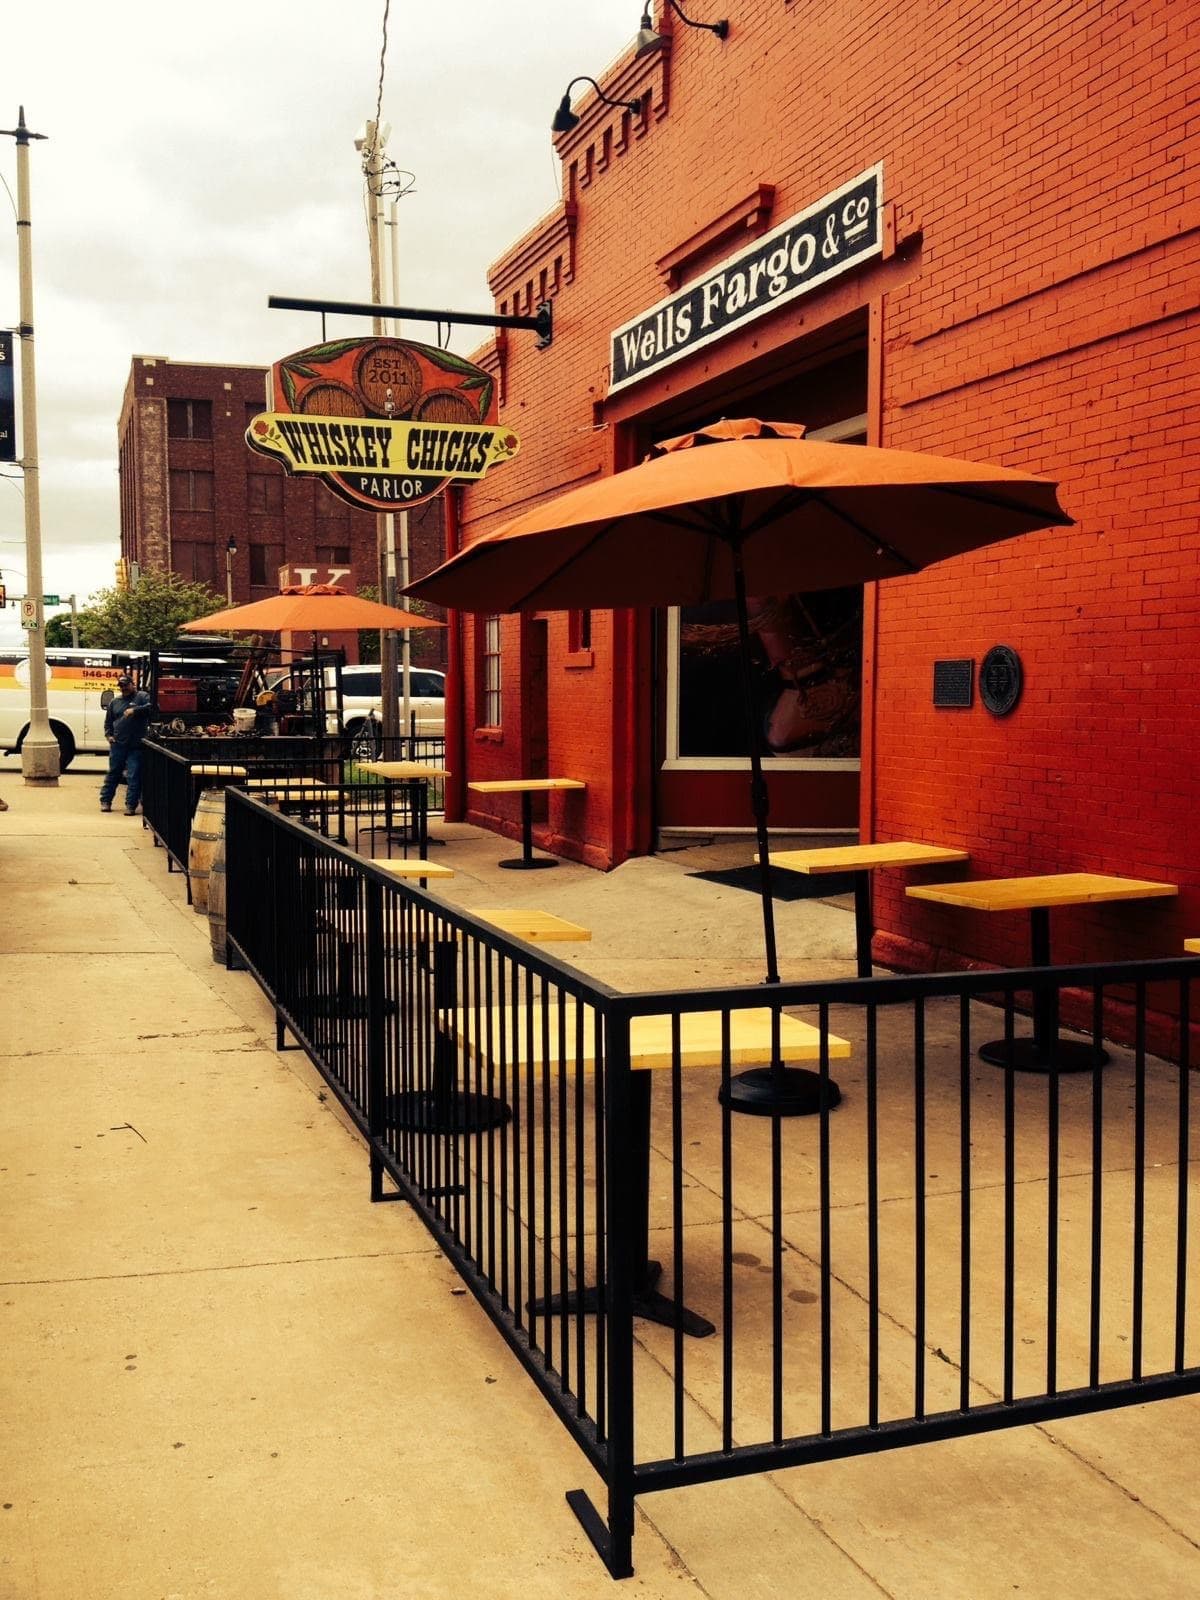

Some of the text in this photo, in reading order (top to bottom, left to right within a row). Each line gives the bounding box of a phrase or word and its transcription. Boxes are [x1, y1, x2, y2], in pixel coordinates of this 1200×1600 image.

[621, 301, 692, 372] Wells
[700, 233, 816, 329] Fargo
[822, 213, 840, 259] &
[373, 358, 402, 370] EST
[369, 369, 410, 385] 2011
[275, 420, 494, 473] WHISKEY CHICKS
[360, 477, 423, 499] PARLOR
